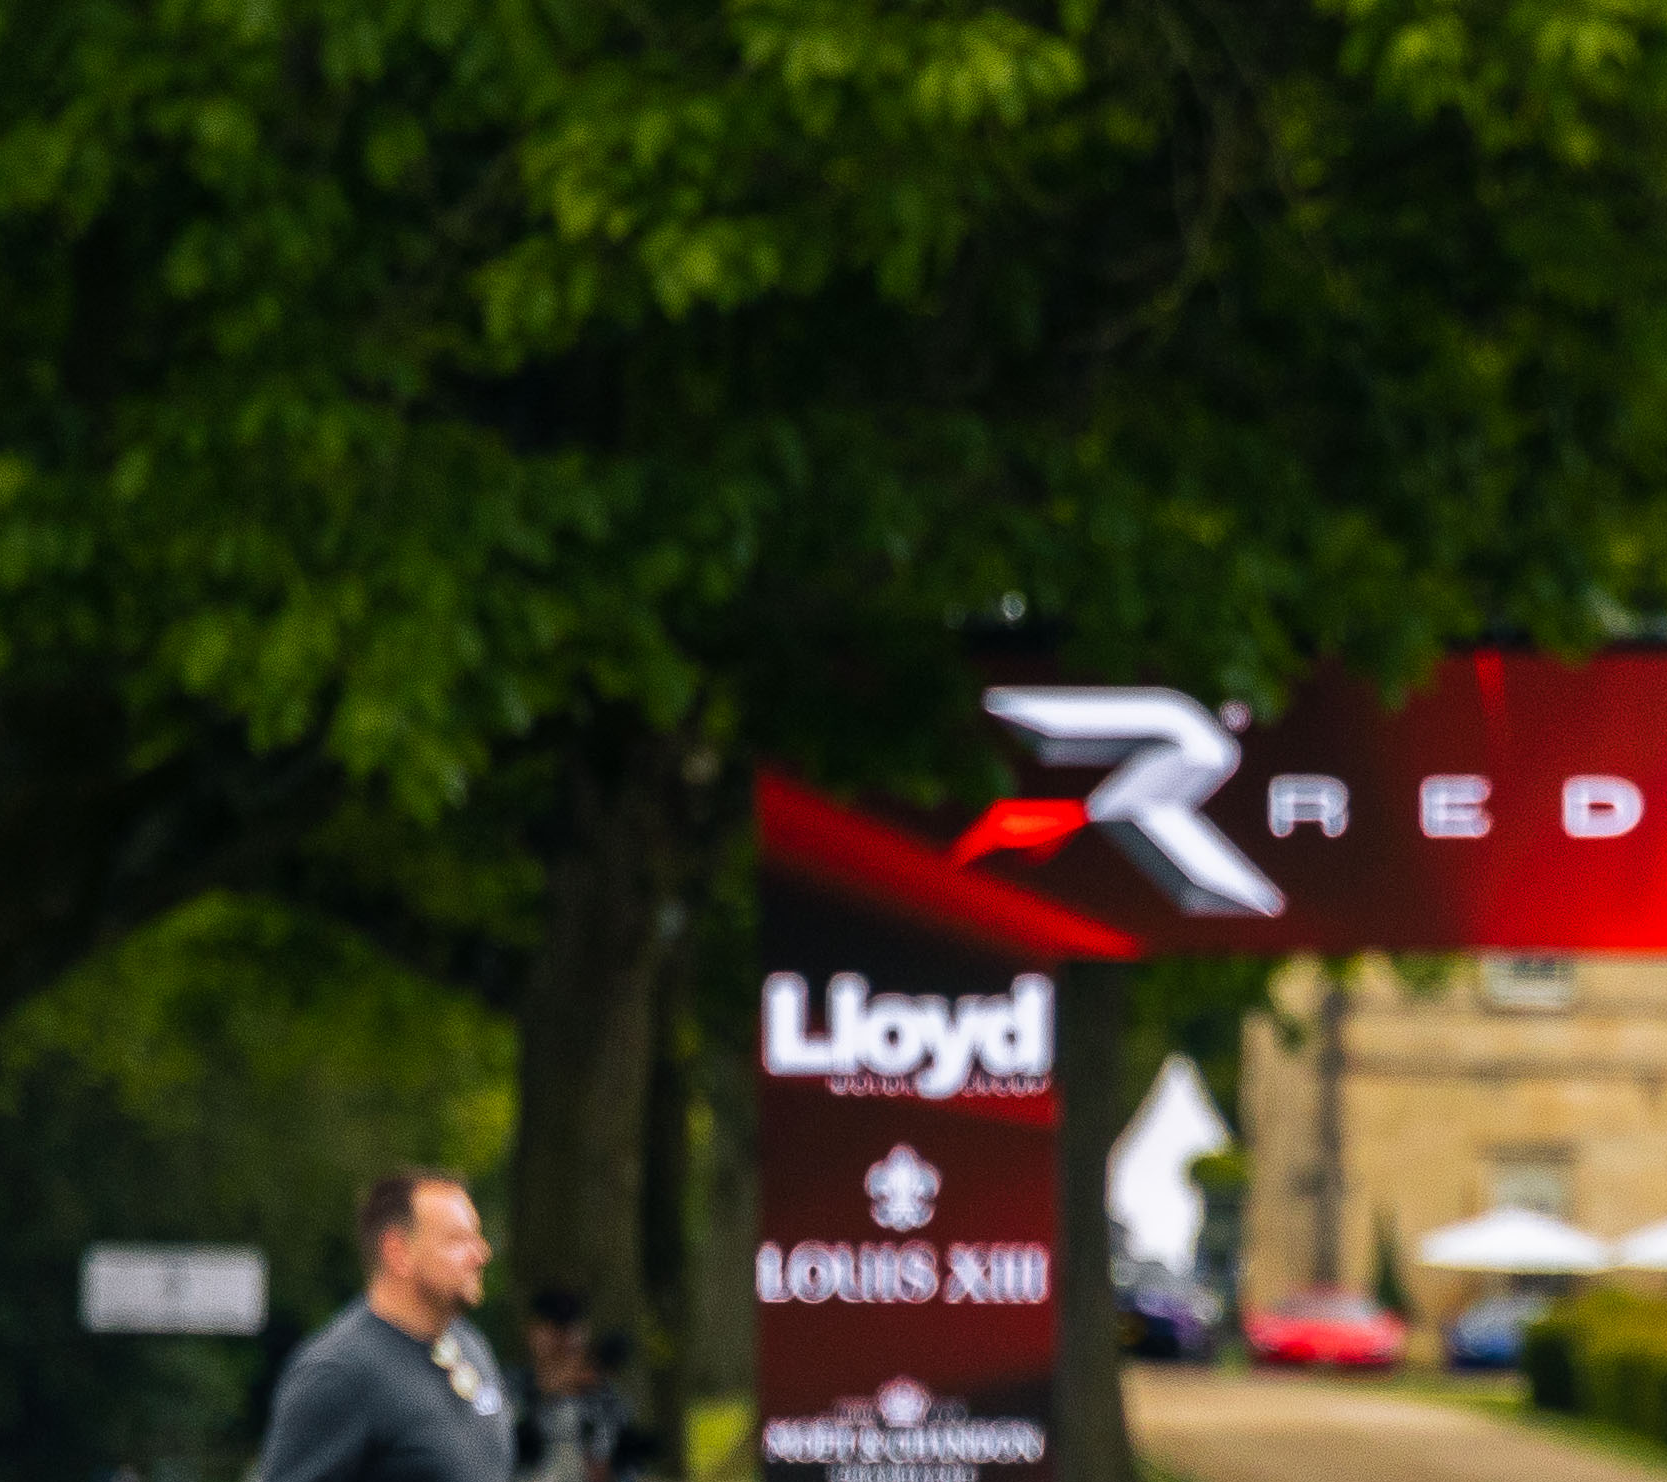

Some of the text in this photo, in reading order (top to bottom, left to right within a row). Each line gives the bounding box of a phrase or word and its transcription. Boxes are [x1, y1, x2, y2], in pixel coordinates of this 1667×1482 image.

[762, 972, 1054, 1099] Lloyd
[756, 1241, 1050, 1304] LOUIS XIII
